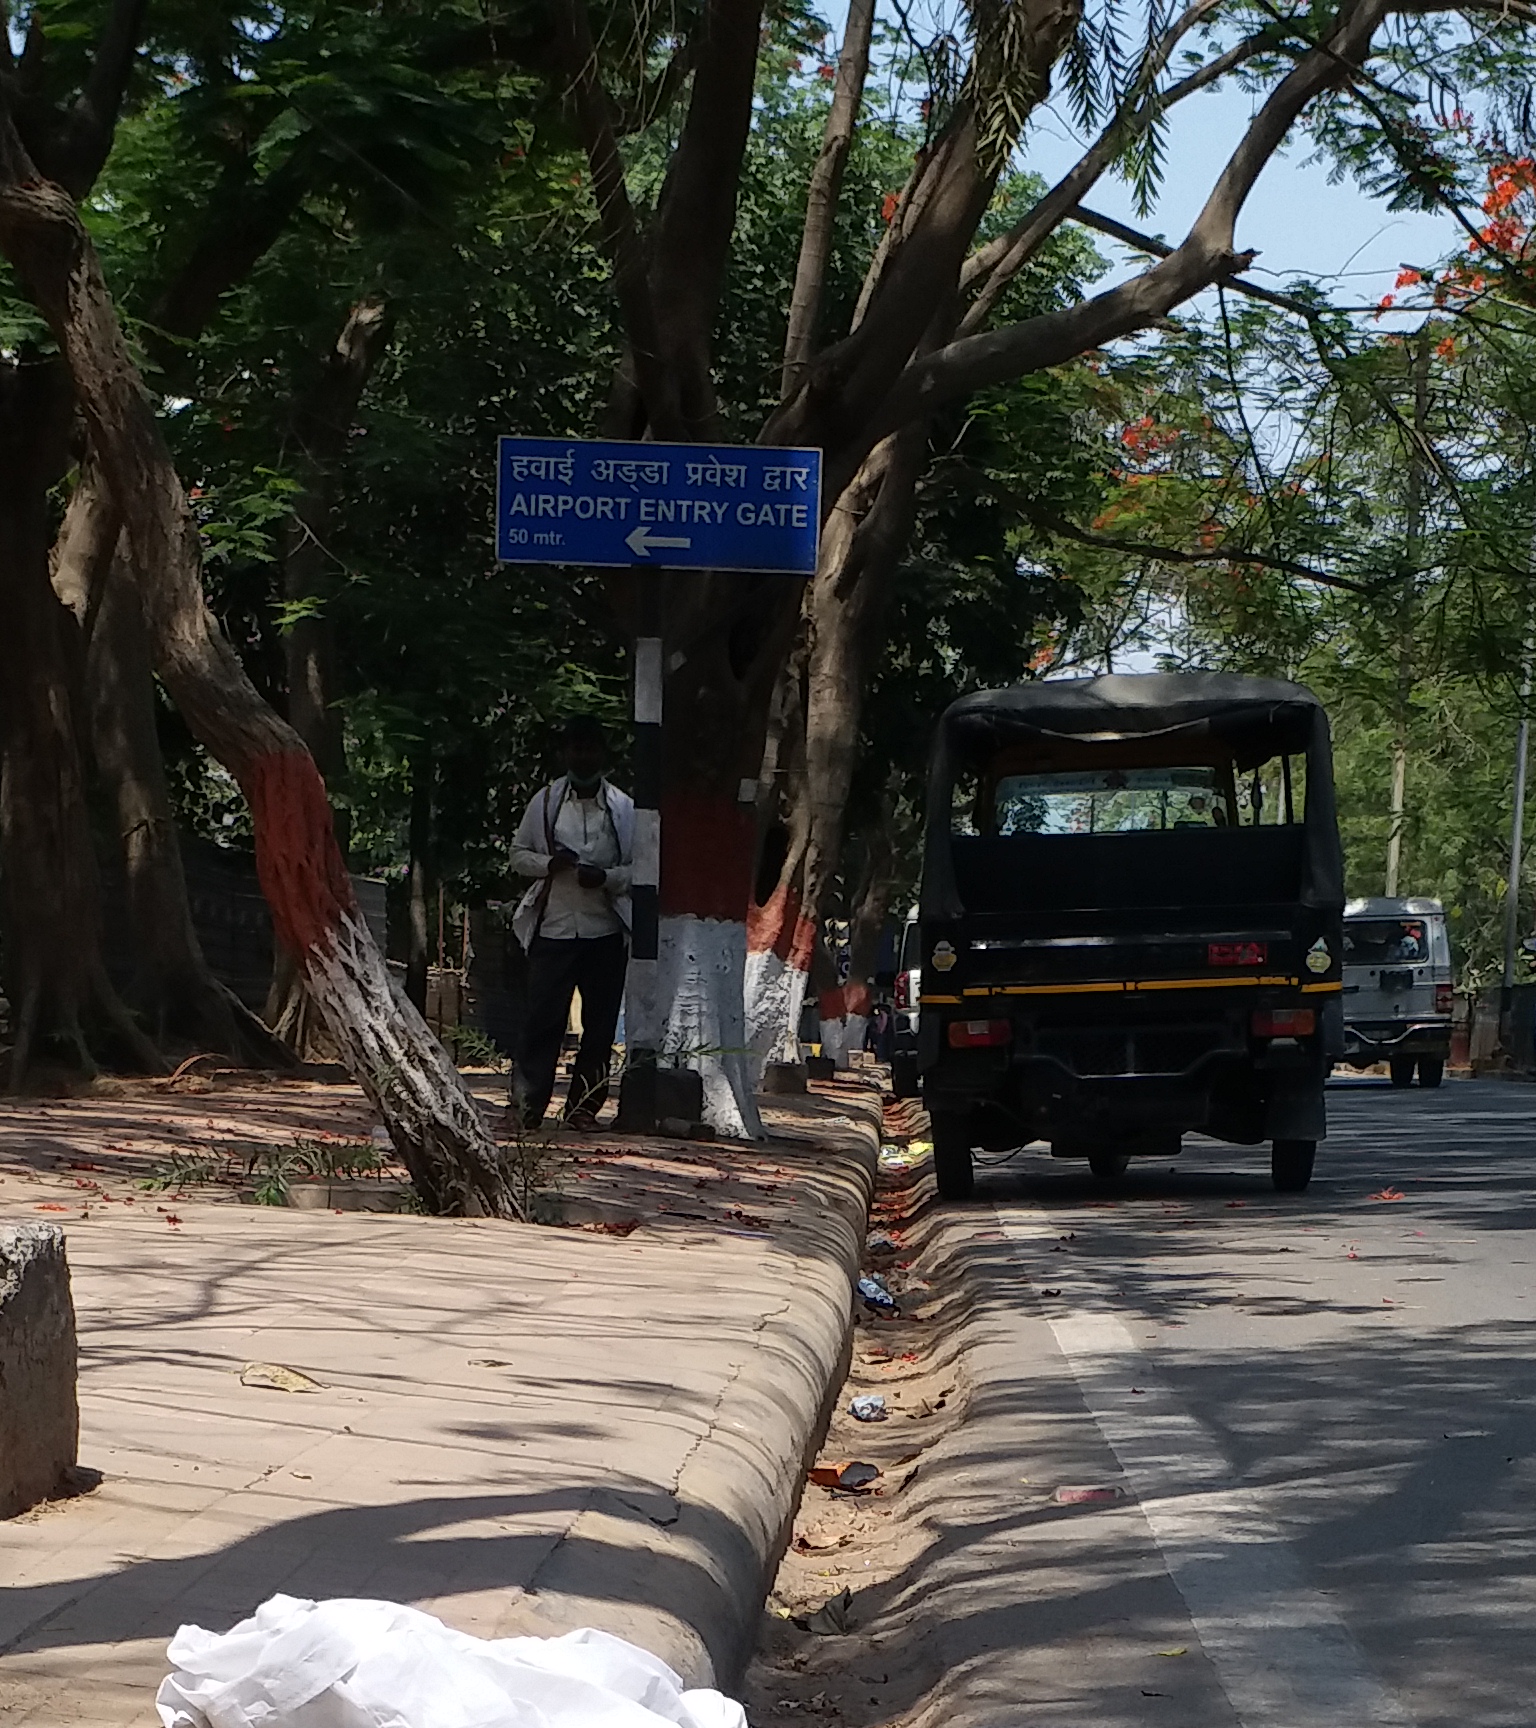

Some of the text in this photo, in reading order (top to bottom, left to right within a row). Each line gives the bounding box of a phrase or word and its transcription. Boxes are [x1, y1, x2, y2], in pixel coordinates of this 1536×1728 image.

[510, 449, 576, 486] हवाई
[685, 454, 748, 489] प्रवेश
[762, 466, 810, 492] द्वार
[509, 493, 809, 529] AIRPORT ENTRY GATE
[508, 528, 566, 546] 50 mtr.
